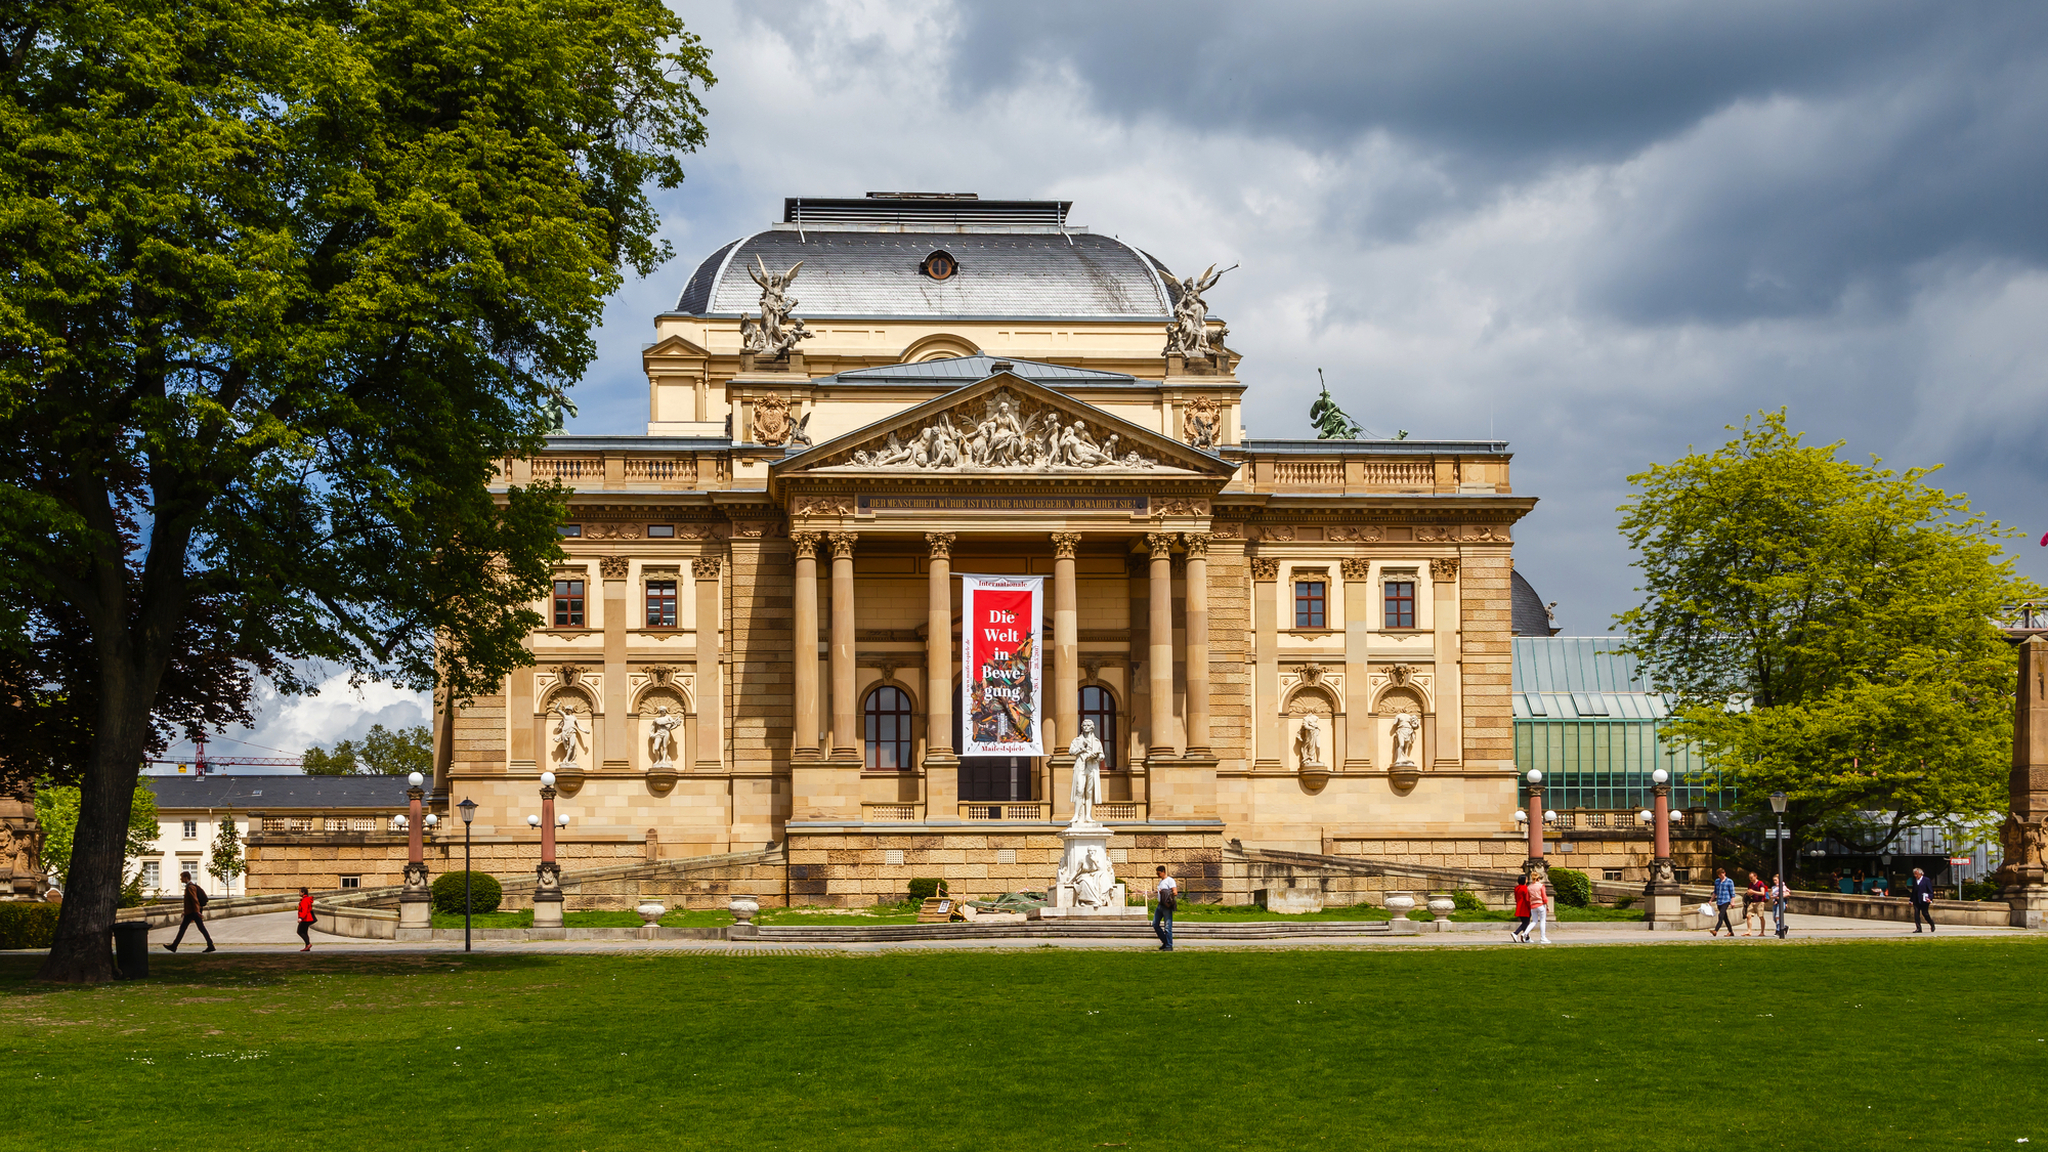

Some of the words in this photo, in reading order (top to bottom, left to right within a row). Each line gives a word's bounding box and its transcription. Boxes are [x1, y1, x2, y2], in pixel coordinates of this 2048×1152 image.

[870, 499, 886, 508] DER
[887, 499, 937, 508] MENSCHHEIT
[938, 497, 967, 508] WÜRDE
[967, 499, 980, 508] IST
[981, 499, 990, 508] IN
[990, 499, 1012, 508] EURE
[1013, 499, 1034, 508] HAND
[1074, 499, 1118, 509] BEWAHRET
[1119, 499, 1136, 509] SIE!
[979, 580, 1028, 588] Internationale
[989, 610, 1015, 624] Die
[984, 628, 1020, 642] Welt
[994, 647, 1010, 660] in
[984, 685, 1021, 702] gung
[981, 745, 1026, 753] Maifestspiele
